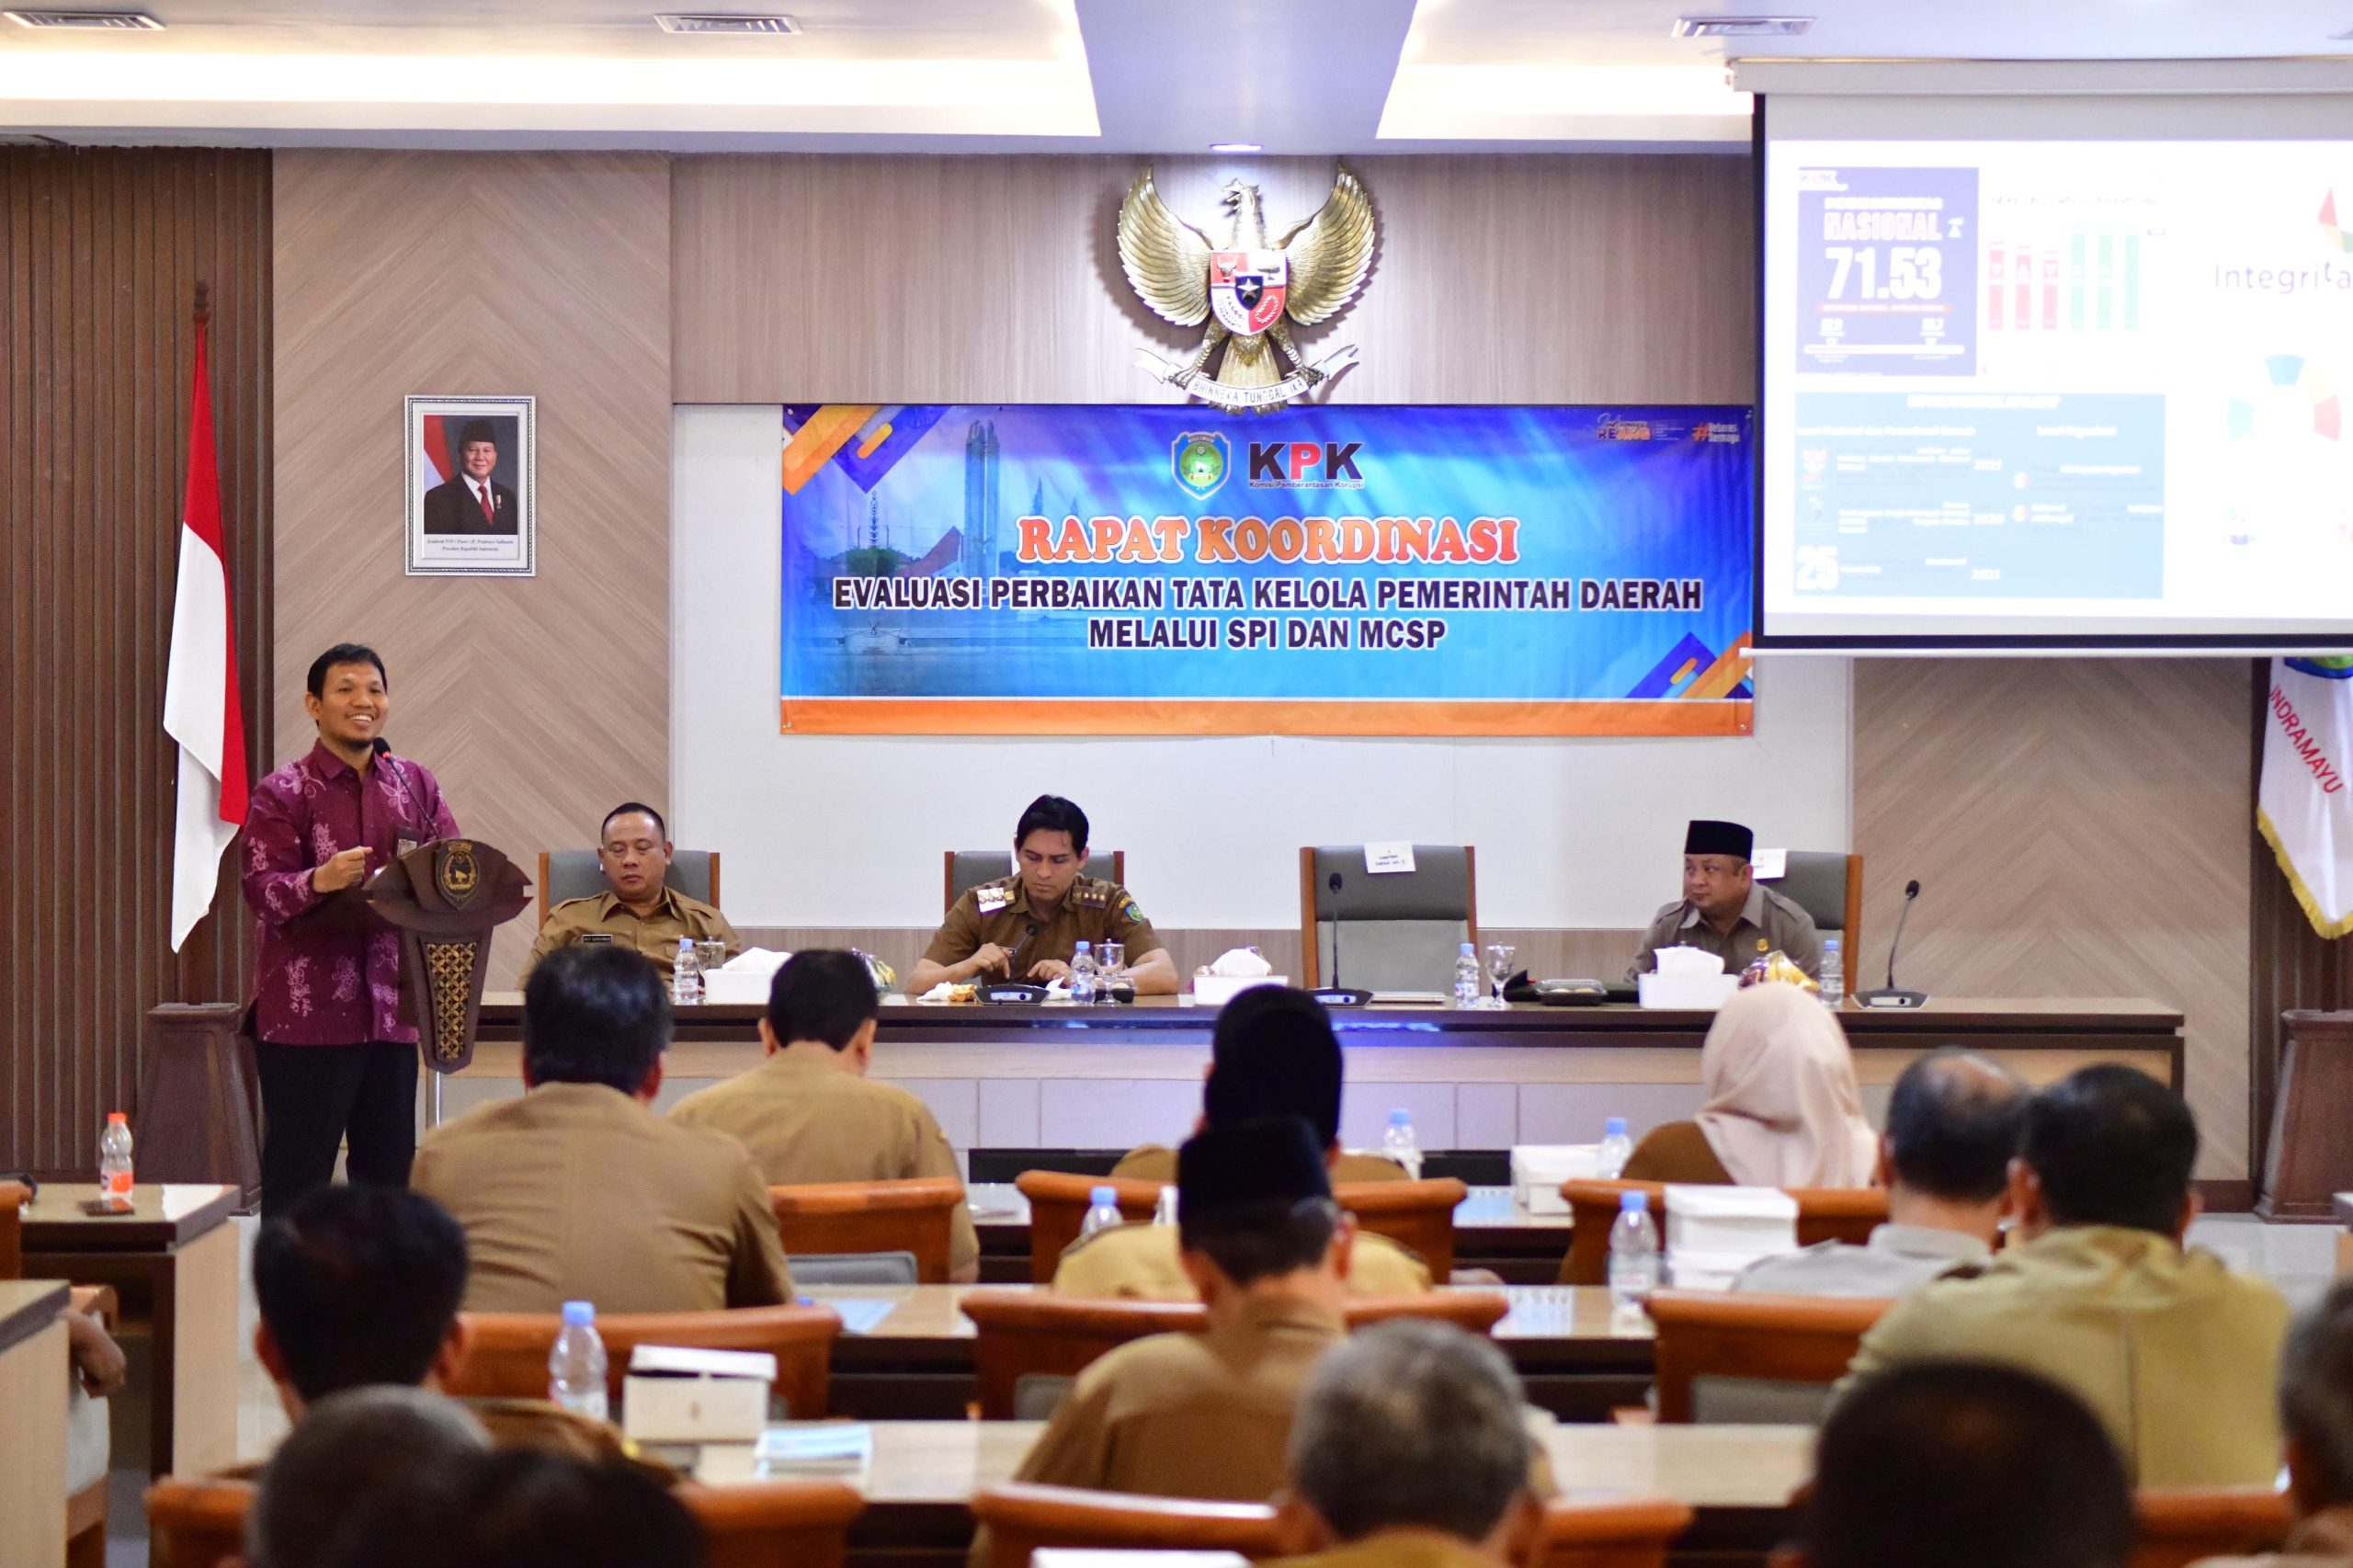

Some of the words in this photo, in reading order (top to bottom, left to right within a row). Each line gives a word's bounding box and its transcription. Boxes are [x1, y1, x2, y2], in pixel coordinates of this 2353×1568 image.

[1824, 211, 1943, 241] NASIONAL
[1825, 246, 1942, 300] 71.53
[1289, 379, 1304, 393] IKA
[1249, 442, 1364, 480] KPK
[1336, 481, 1365, 490] Korupsi
[1018, 517, 1188, 562] RAPAT
[1198, 517, 1519, 562] KOORDINASI
[1796, 545, 1838, 591] 25
[835, 579, 980, 608] EVALUASI
[991, 579, 1163, 608] PERBAIKAN
[1172, 579, 1245, 608] TATA
[1254, 580, 1366, 608] KELOLA
[1378, 580, 1570, 609] PEMERINTAH
[1581, 581, 1701, 609] DAERAH
[1089, 619, 1218, 648] MELALUI
[1227, 619, 1277, 648] SPI
[1288, 619, 1348, 648] DAN
[1359, 619, 1446, 648] MCSP
[2268, 685, 2344, 794] INDRAMAYU
